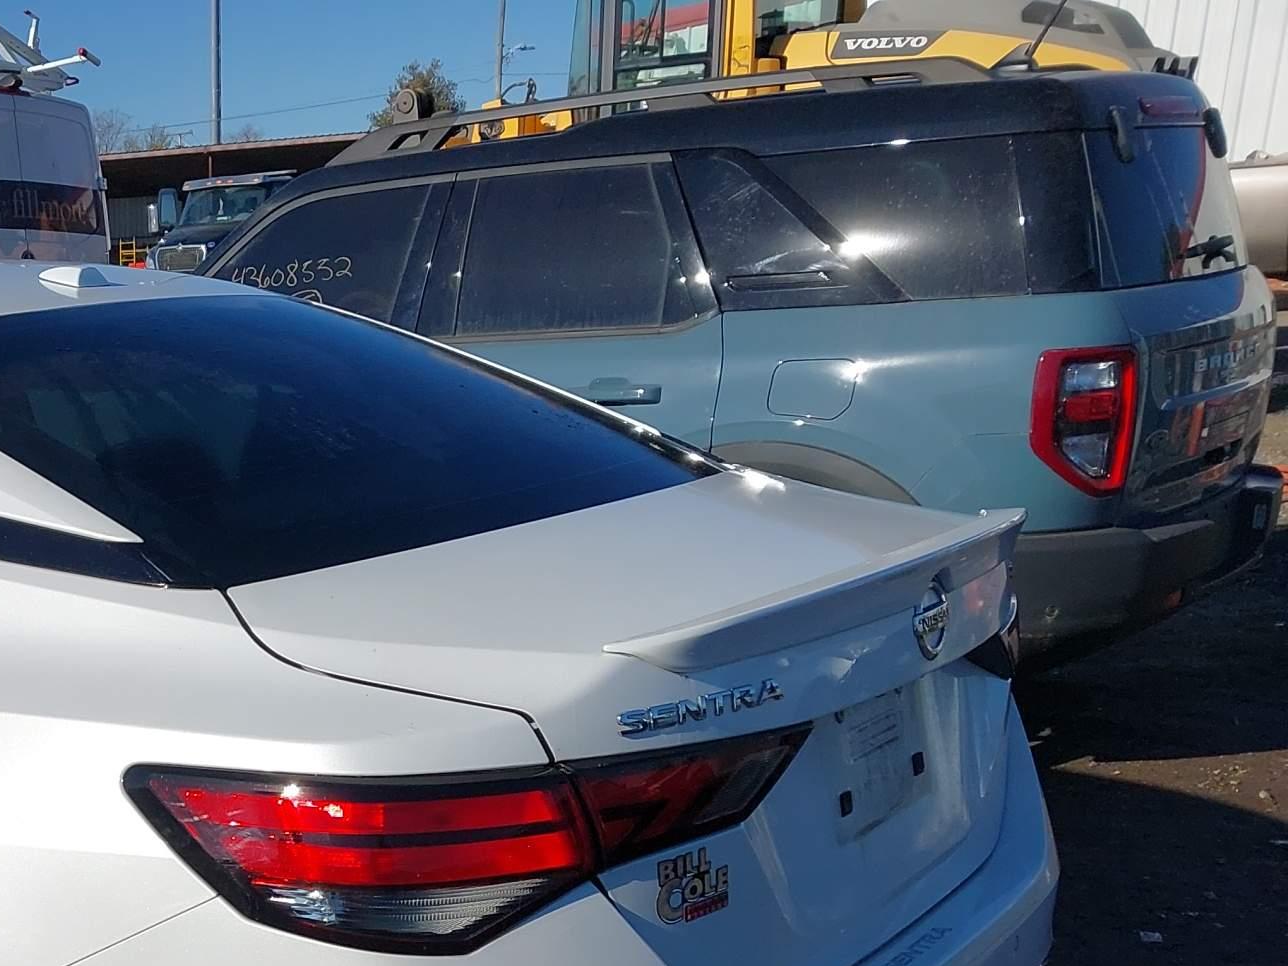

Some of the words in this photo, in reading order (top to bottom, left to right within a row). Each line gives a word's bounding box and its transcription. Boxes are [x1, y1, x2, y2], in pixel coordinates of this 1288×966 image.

[844, 36, 928, 50] VOLVO
[232, 256, 353, 288] 43608532
[616, 678, 784, 737] SENTRA
[657, 846, 712, 888] BILL
[656, 864, 729, 925] COLE
